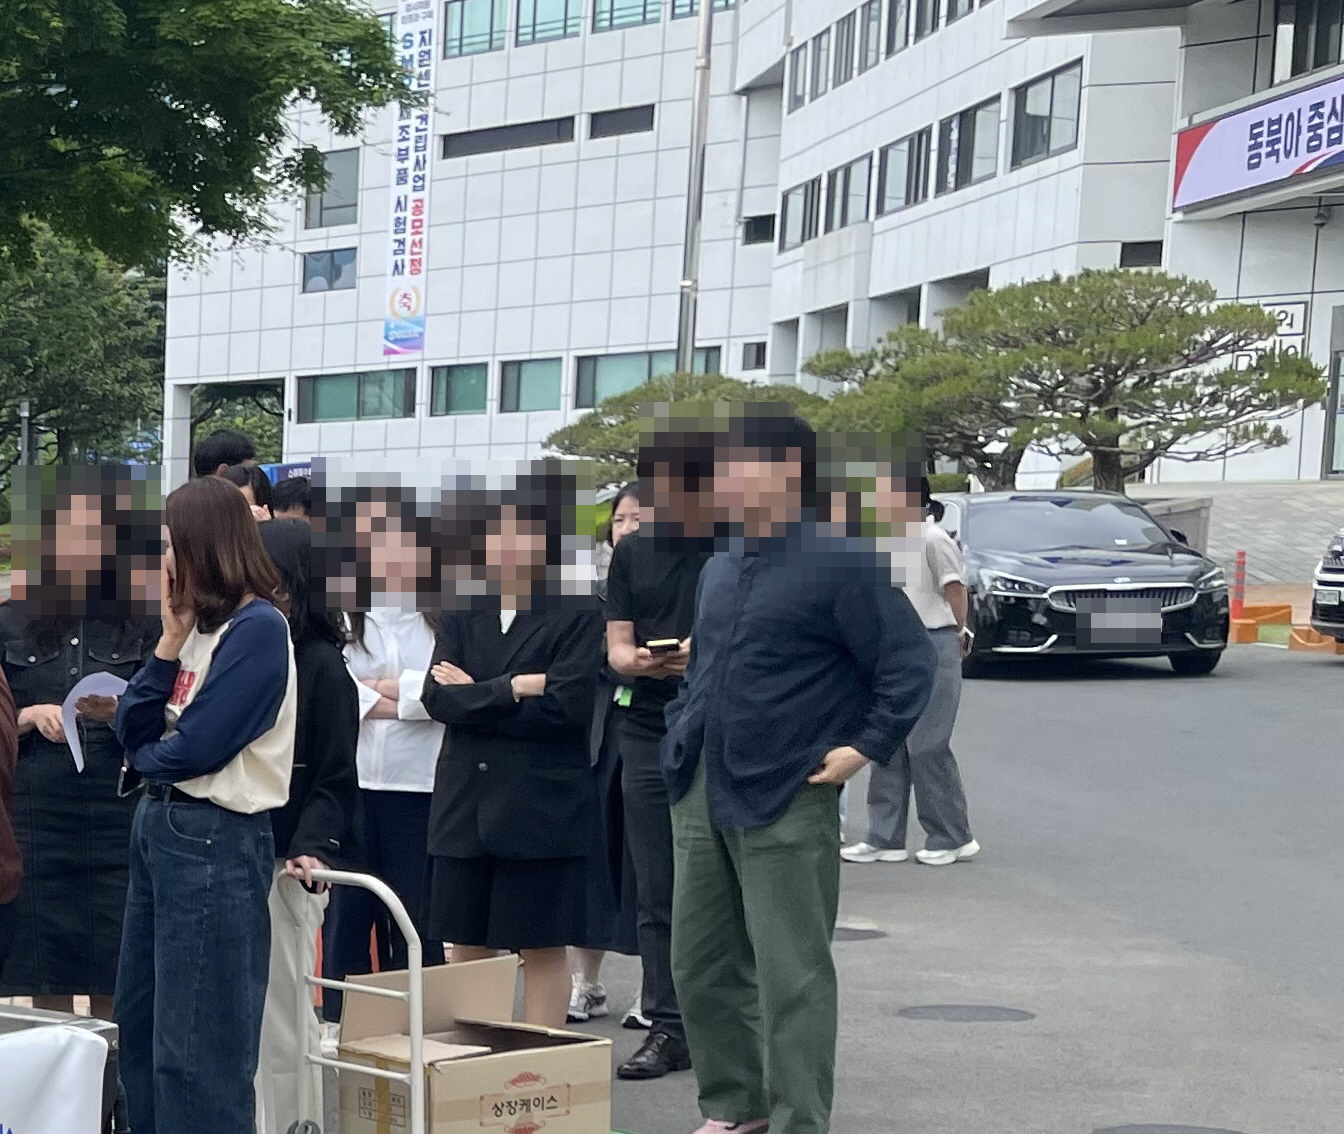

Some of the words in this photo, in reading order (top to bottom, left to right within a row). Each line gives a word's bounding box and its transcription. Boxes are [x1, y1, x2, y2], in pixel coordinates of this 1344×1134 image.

[416, 28, 432, 107] 지원센
[413, 113, 429, 192] 건립사업
[1248, 108, 1302, 171] 동북아
[392, 195, 407, 276] 시험검사
[409, 198, 425, 276] 공모선정
[492, 1095, 559, 1117] 상장케이스
